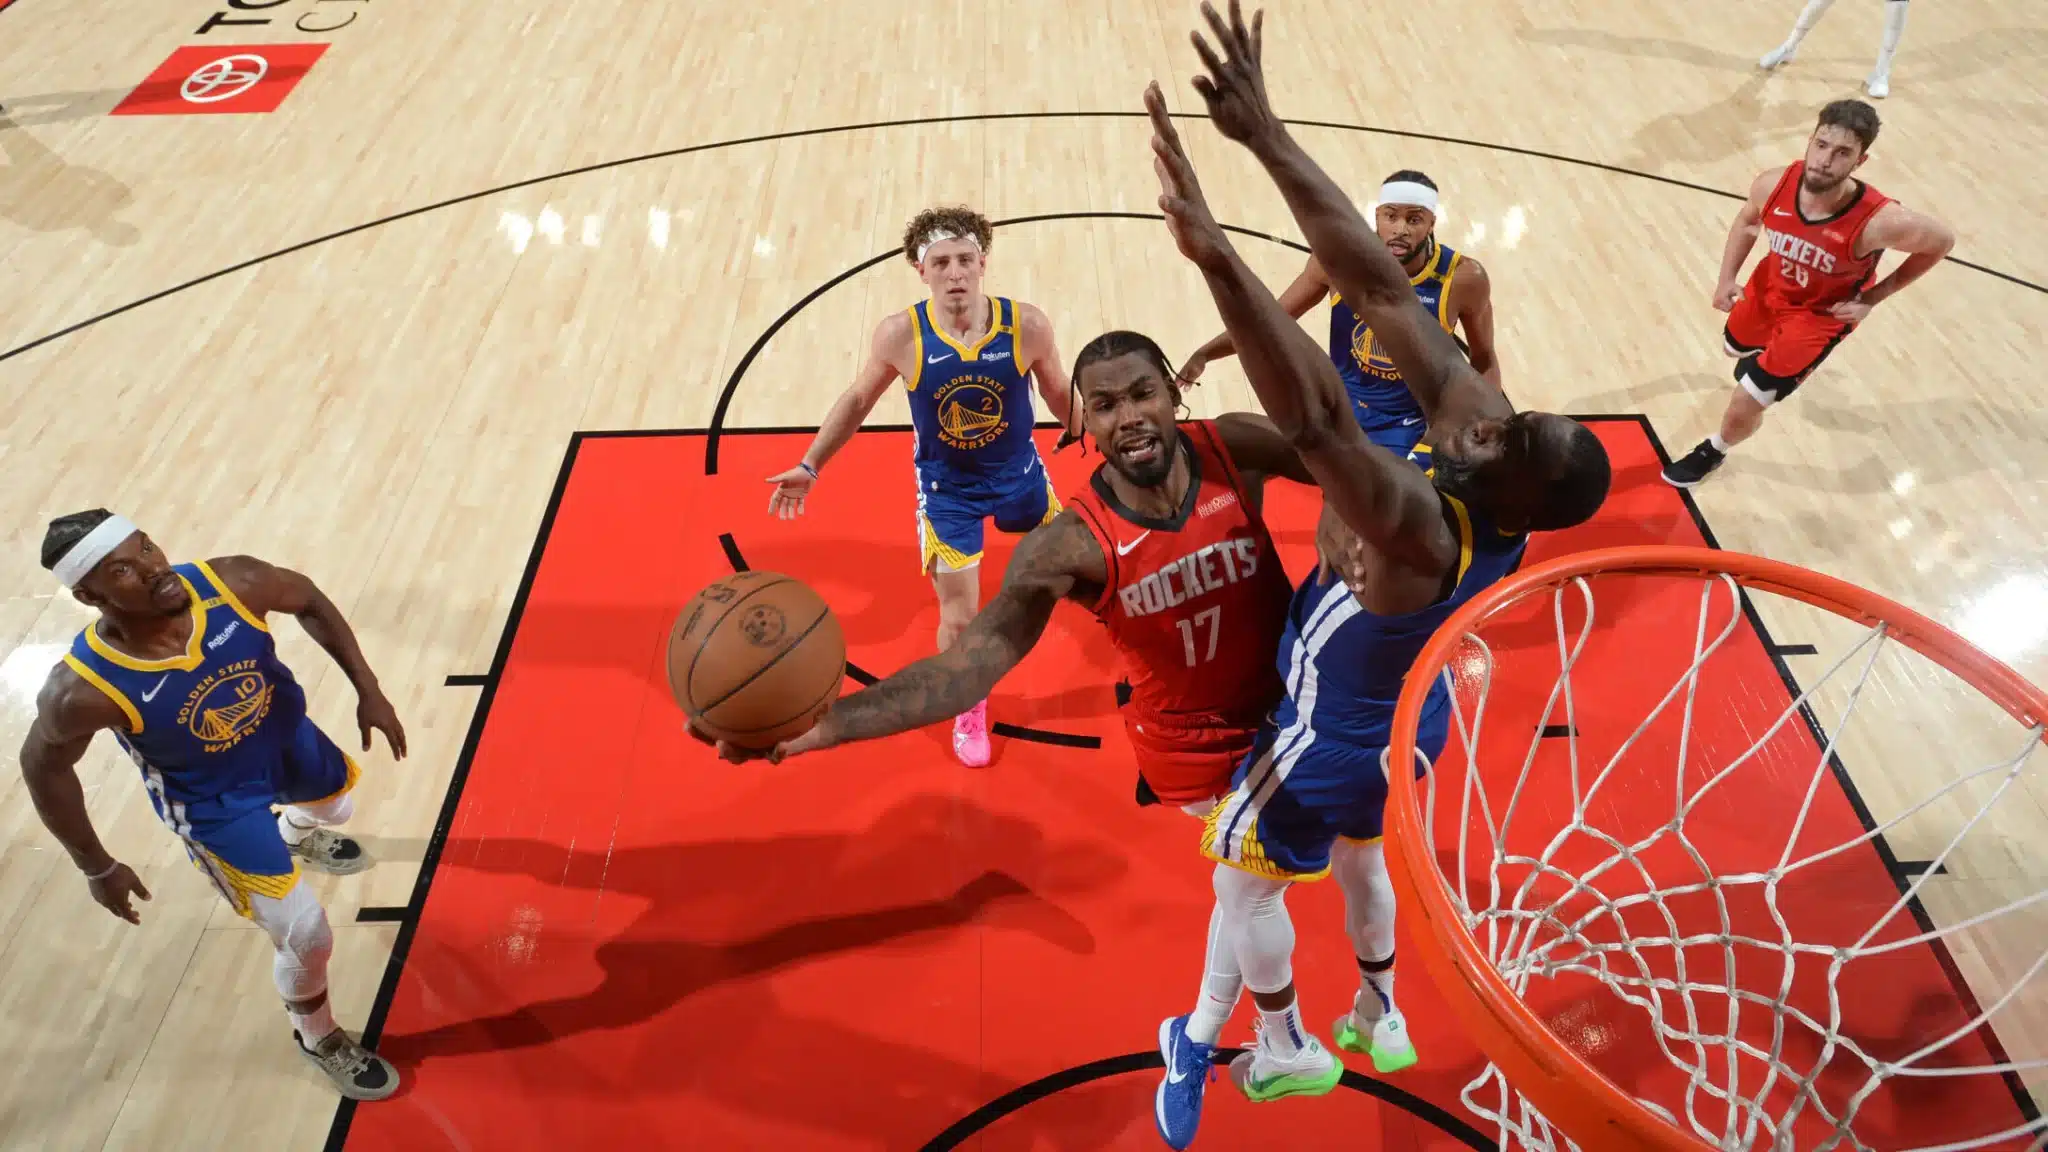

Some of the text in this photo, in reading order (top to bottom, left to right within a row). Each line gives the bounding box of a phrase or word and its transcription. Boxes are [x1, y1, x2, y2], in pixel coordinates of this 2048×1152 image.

[982, 351, 1011, 361] Rakuten
[1350, 347, 1402, 381] WARRIO
[933, 375, 1007, 399] GOLDEN STATE
[981, 397, 993, 411] 2
[938, 421, 1009, 450] WARRIORS
[1118, 537, 1259, 618] ROCKETS
[207, 620, 240, 650] Rakuten
[1176, 605, 1221, 667] 17
[177, 660, 257, 724] GOLDEN STATE
[234, 677, 257, 700] 10
